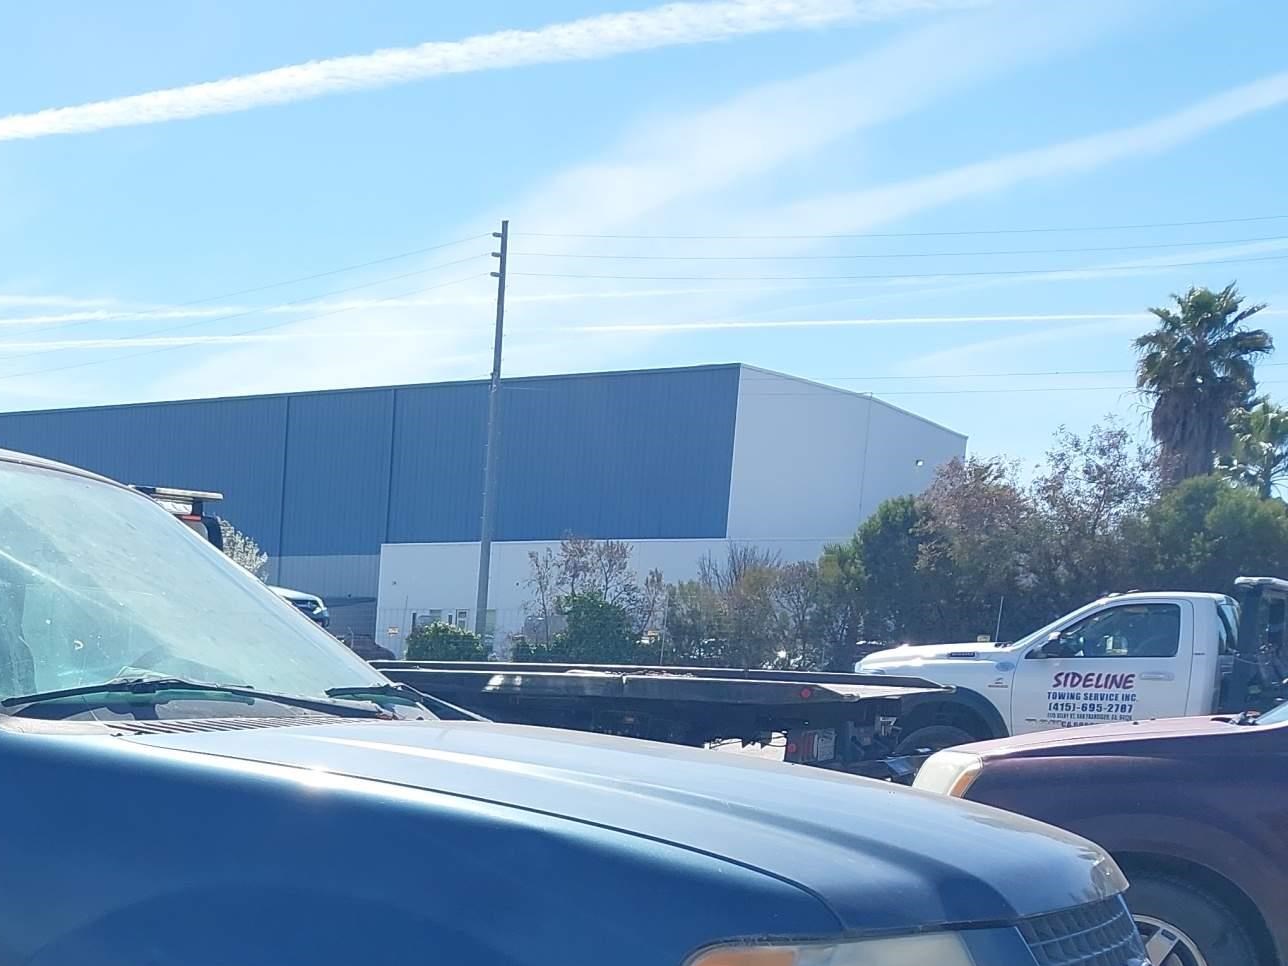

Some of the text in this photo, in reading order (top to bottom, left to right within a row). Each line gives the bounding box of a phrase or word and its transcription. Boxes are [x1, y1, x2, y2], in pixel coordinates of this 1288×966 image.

[1052, 672, 1136, 689] SIDELINE
[1047, 691, 1081, 701] TOWING
[1083, 692, 1119, 701] SERVICE
